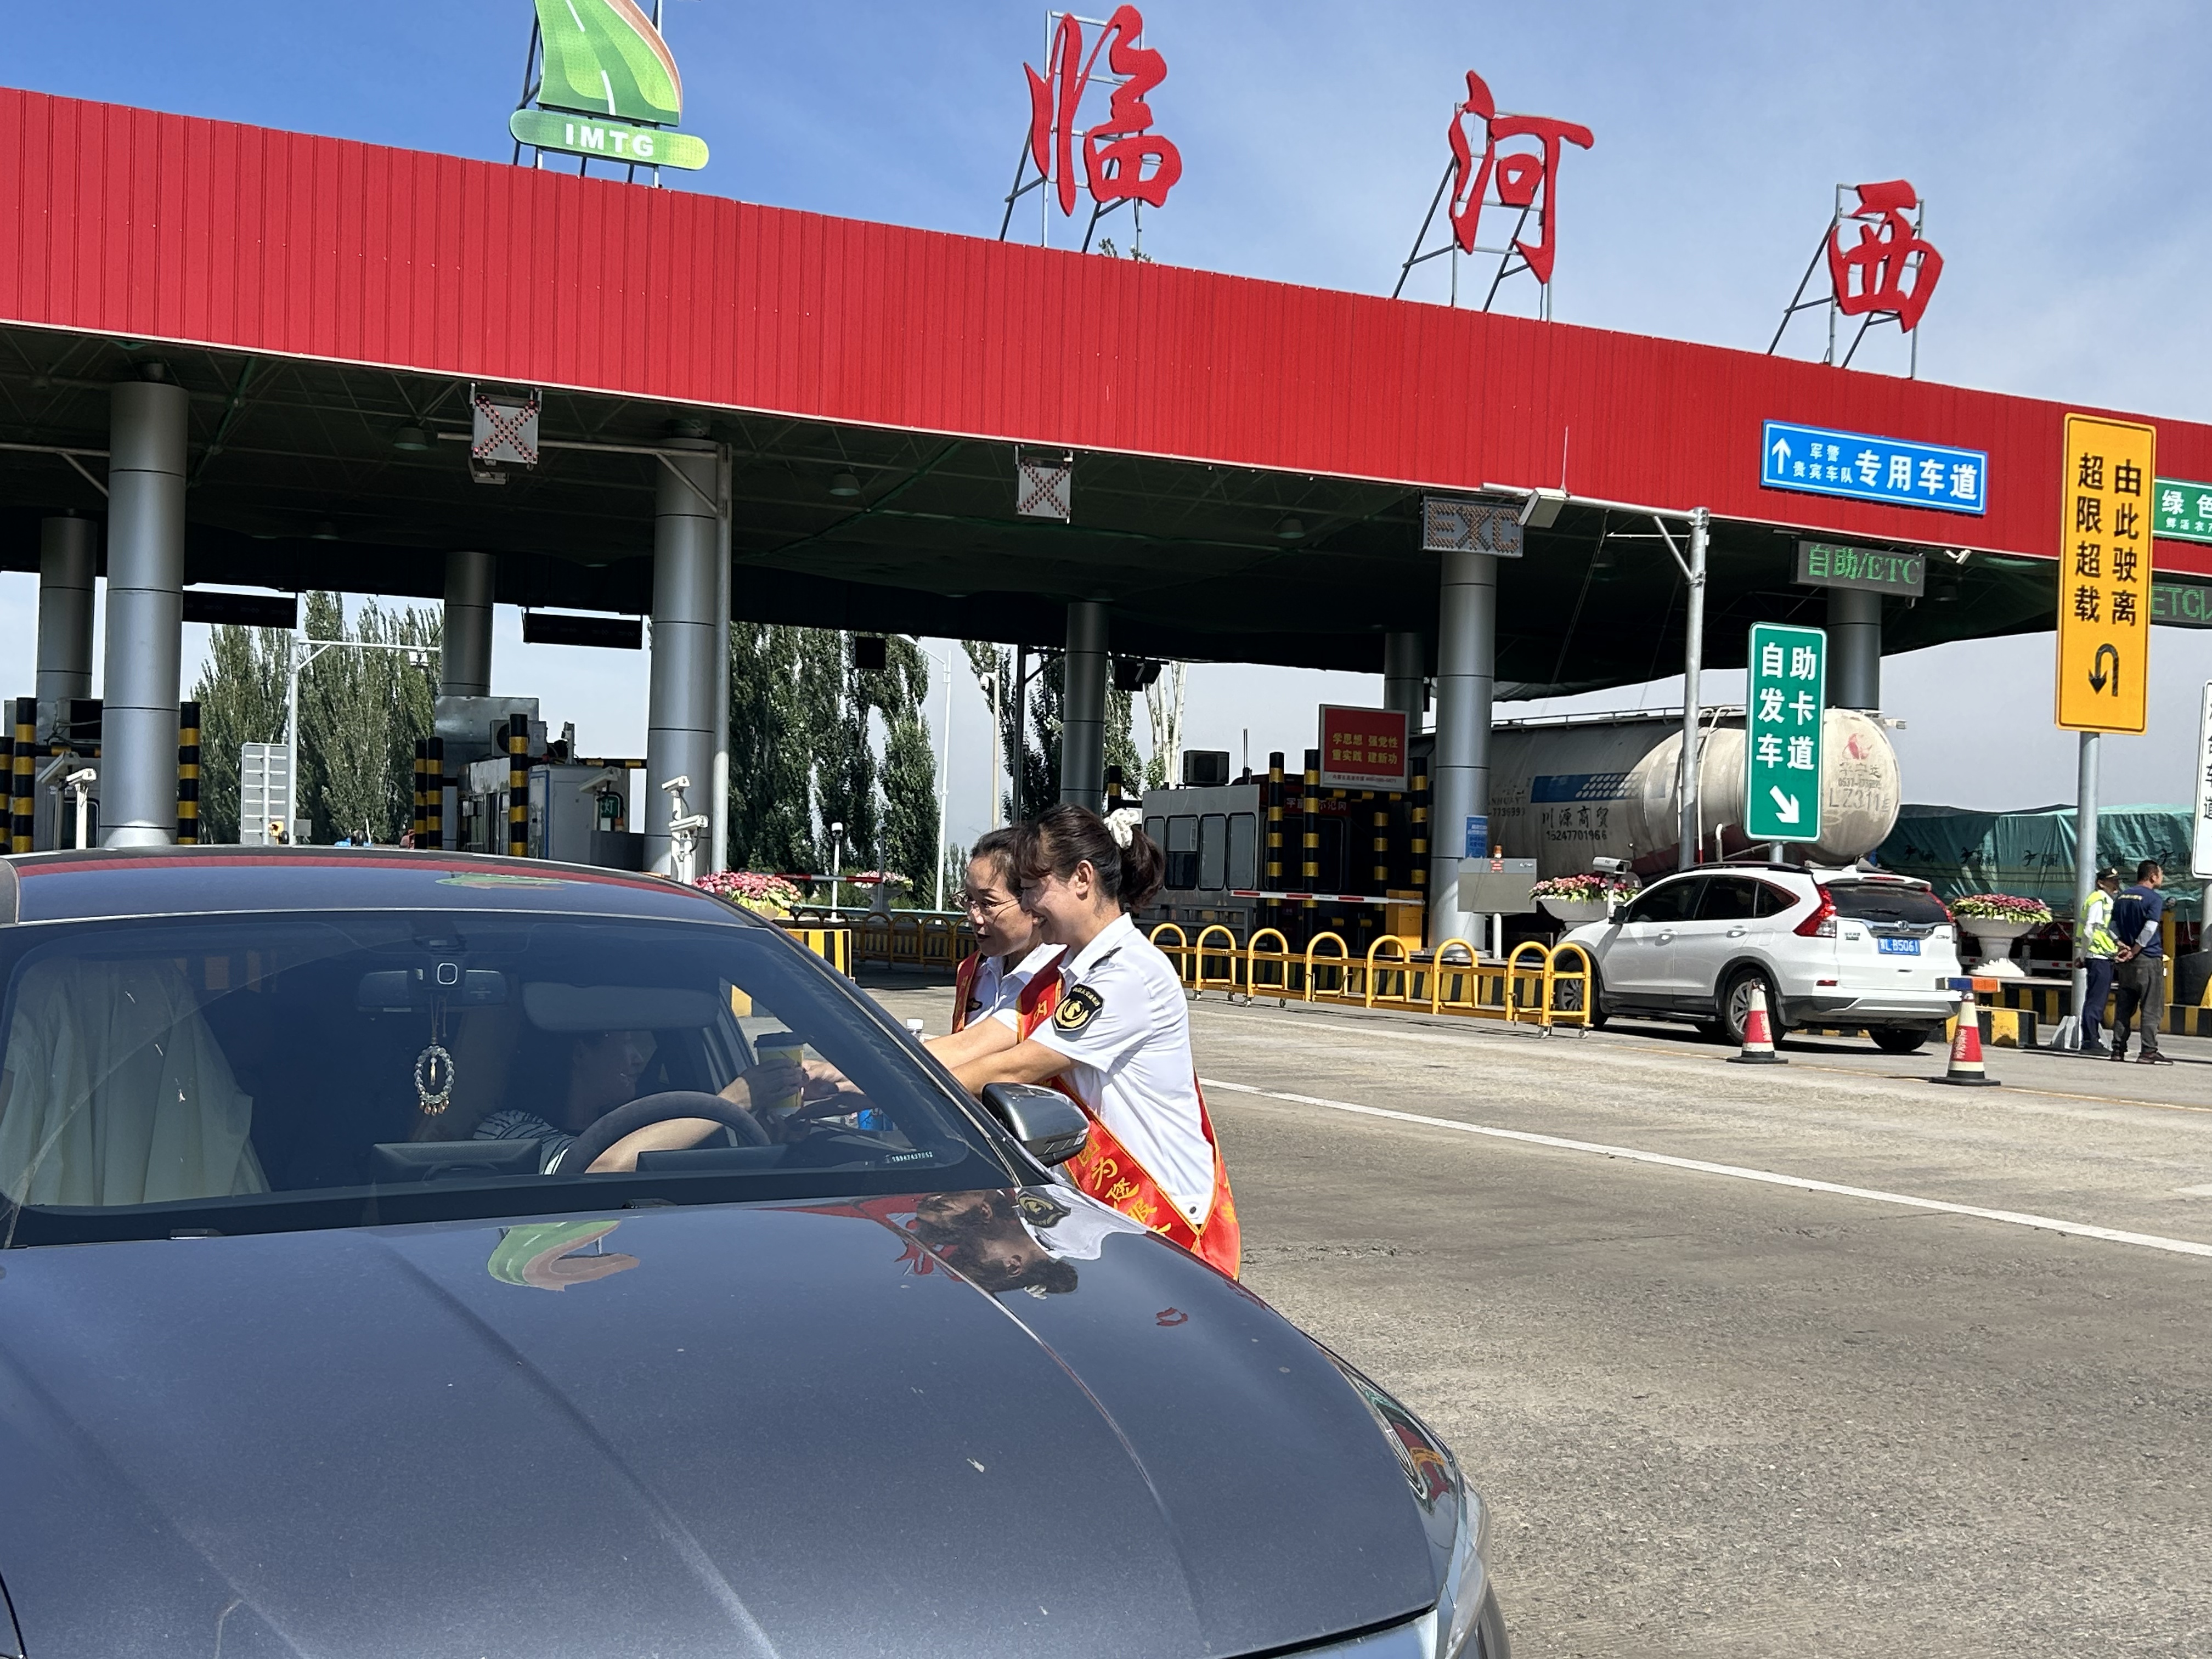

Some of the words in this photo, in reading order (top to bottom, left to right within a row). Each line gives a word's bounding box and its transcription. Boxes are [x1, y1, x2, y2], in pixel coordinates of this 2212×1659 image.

[566, 123, 653, 157] IMTG
[1810, 443, 1841, 462] 军警
[1793, 460, 1853, 484] 贵宾车队
[1855, 449, 1977, 500] 专用车道
[2074, 452, 2103, 623] 超限超载
[2112, 459, 2141, 627] 由此驶离
[1808, 544, 1922, 585] 自助/ETC
[1761, 641, 1817, 681] 自助
[1758, 688, 1816, 725] 发卡
[1333, 733, 1363, 746] 学思想
[1368, 735, 1398, 748] 强党性
[1368, 752, 1398, 764] 建新功
[1756, 733, 1814, 771] 车道
